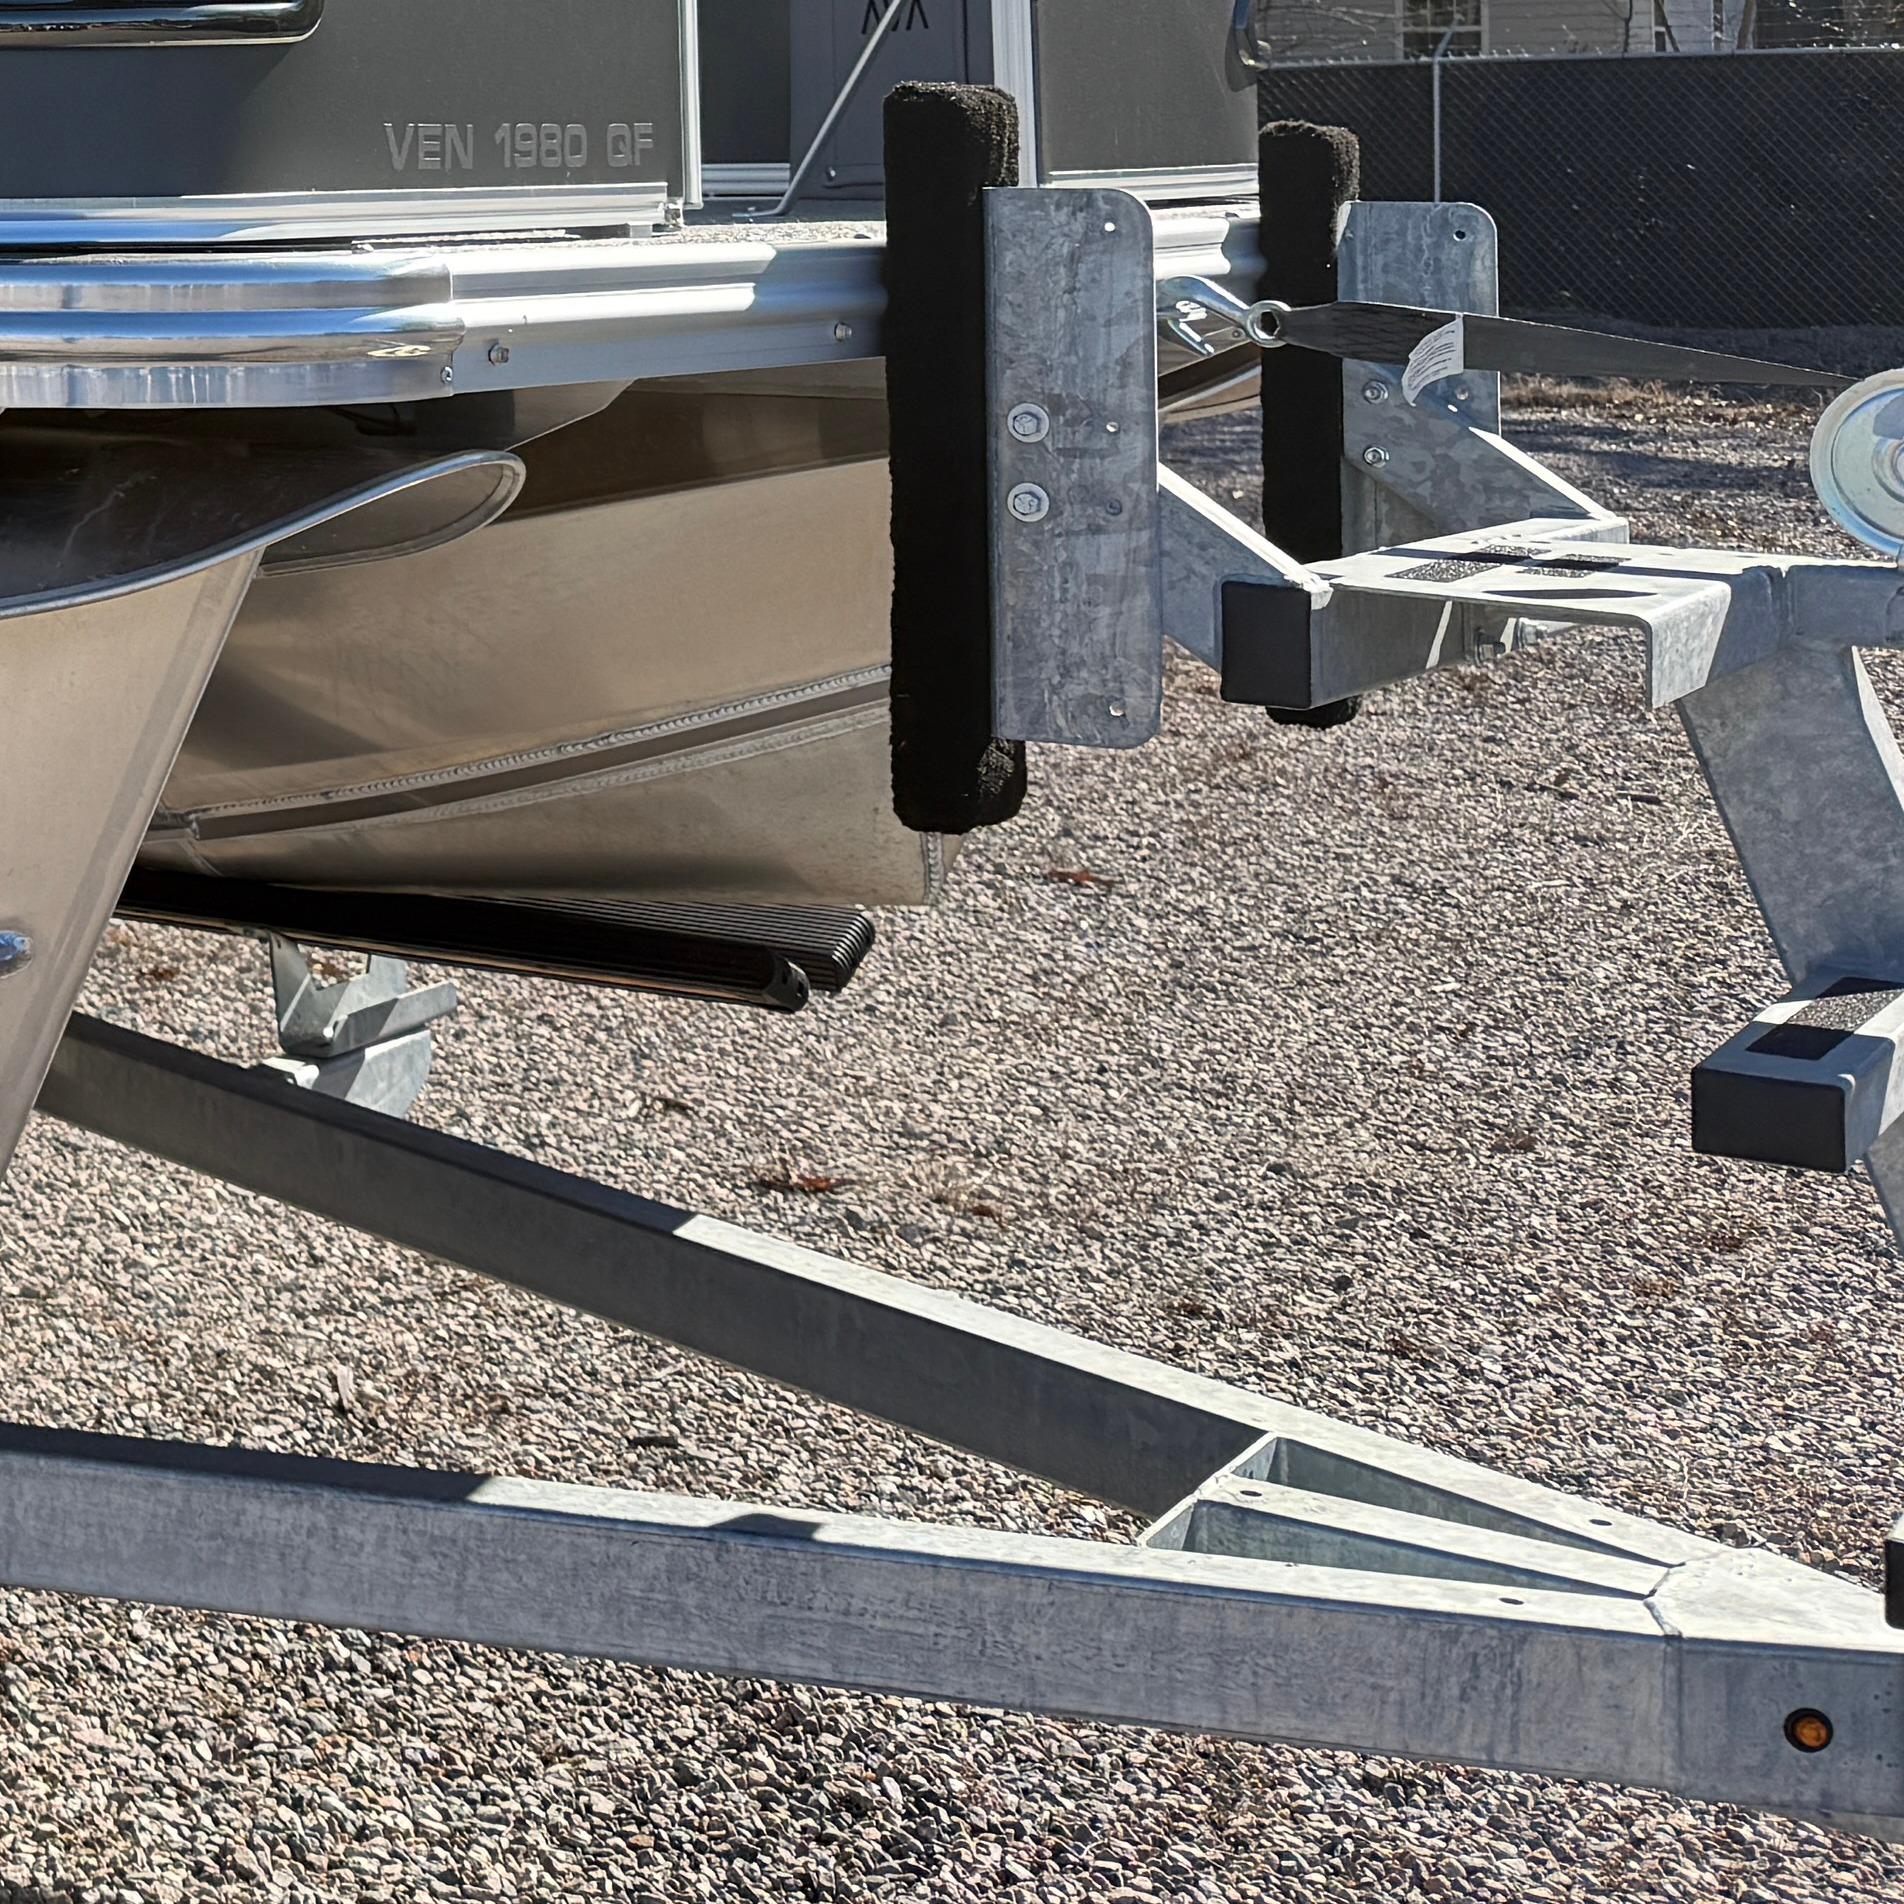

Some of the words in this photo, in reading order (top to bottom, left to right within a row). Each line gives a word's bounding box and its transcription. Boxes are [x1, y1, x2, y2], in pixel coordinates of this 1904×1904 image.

[383, 122, 474, 171] VEN
[494, 122, 588, 168] 1980
[606, 122, 654, 168] QF
